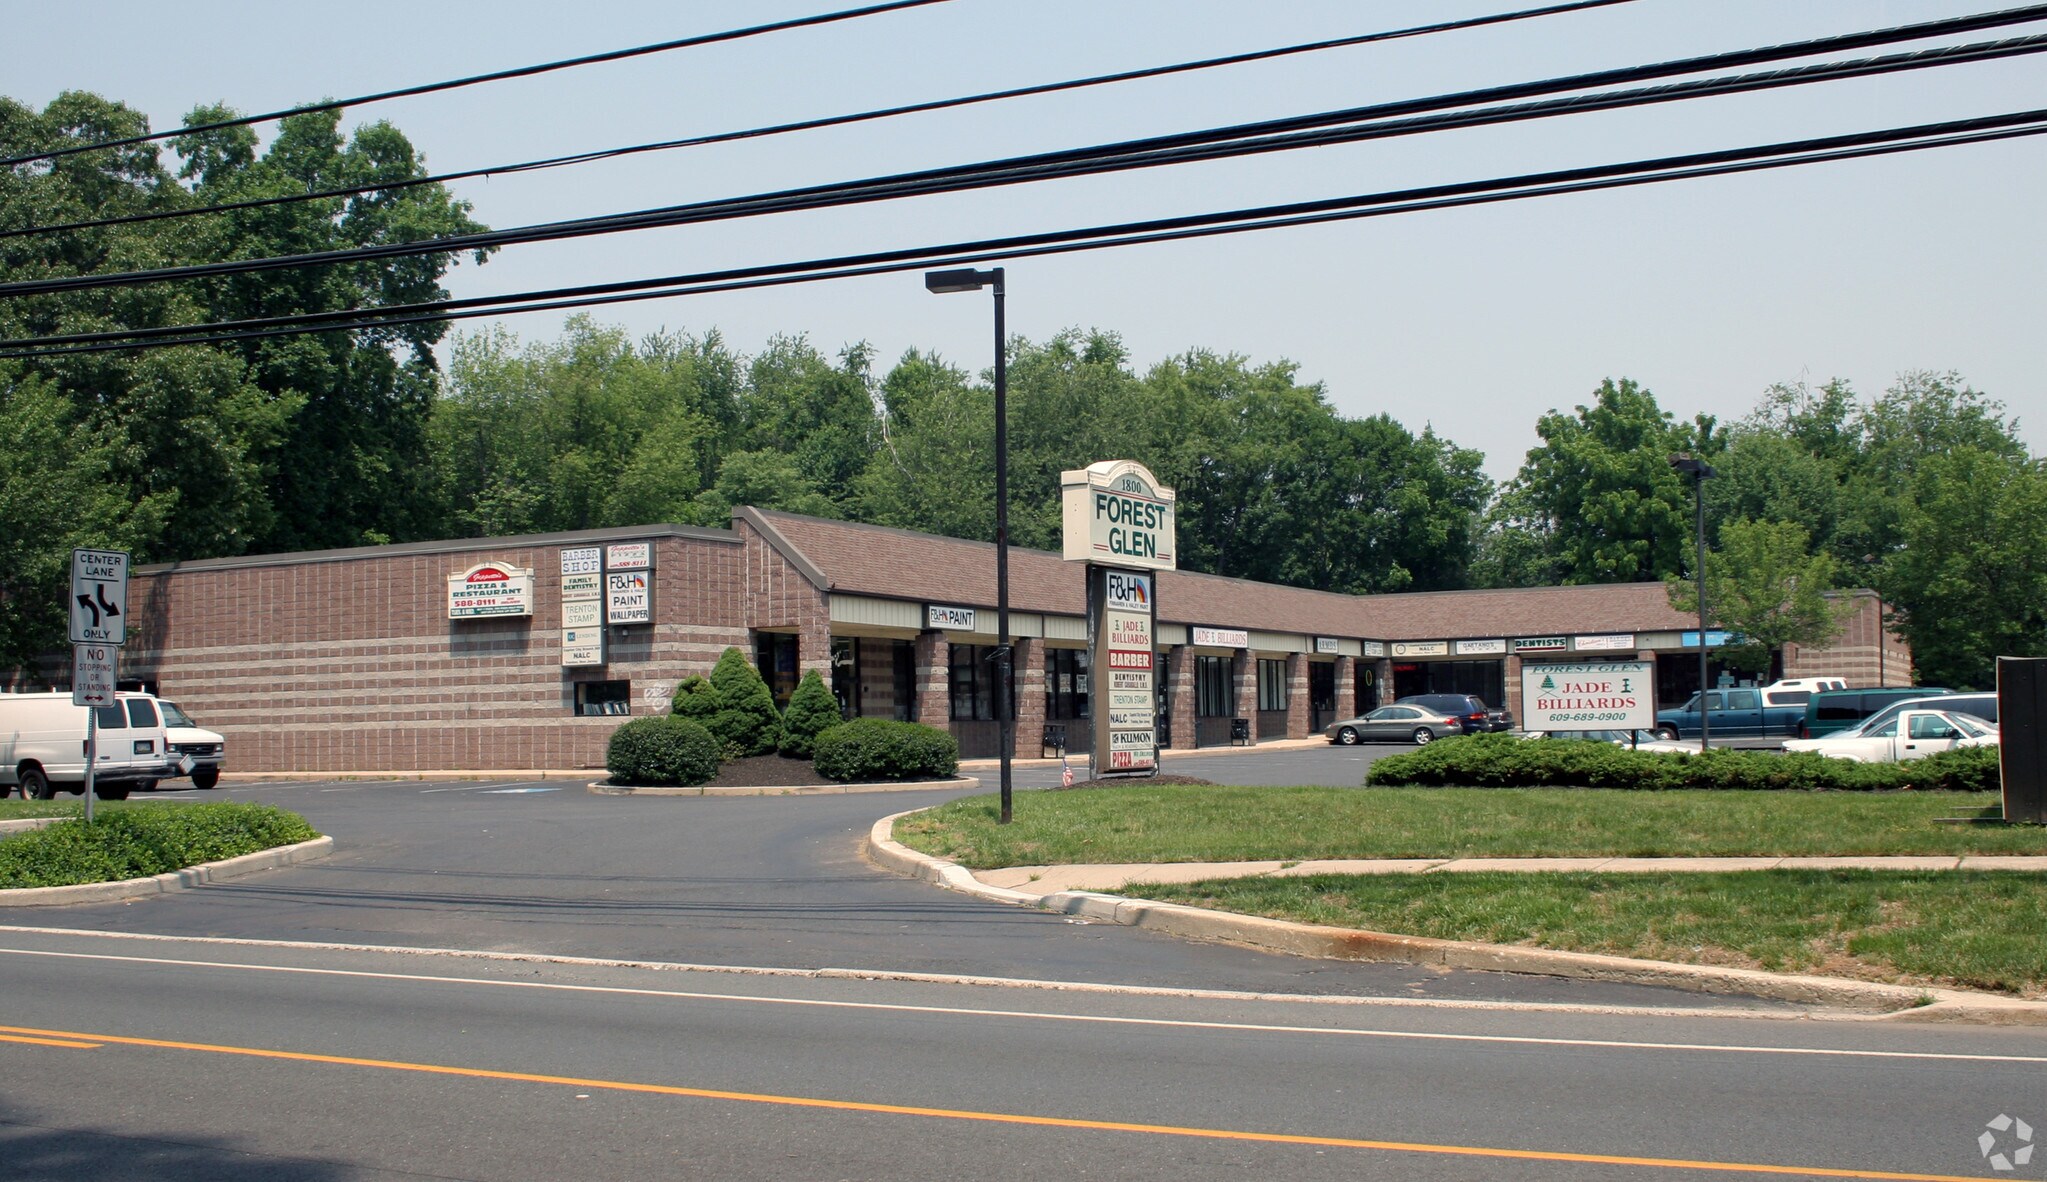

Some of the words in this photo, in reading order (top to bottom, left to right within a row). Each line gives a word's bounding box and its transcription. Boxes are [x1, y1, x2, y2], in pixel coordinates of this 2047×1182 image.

[1122, 479, 1141, 493] 1800
[1096, 494, 1166, 530] FOREST
[1109, 527, 1155, 558] GLEN
[80, 554, 121, 566] CENTER
[562, 550, 598, 561] BARBER
[85, 567, 115, 577] LANE
[563, 561, 599, 572] SHOP
[610, 575, 636, 589] F&H
[453, 588, 522, 597] RESTAURANT
[1109, 575, 1137, 602] F&H
[454, 599, 496, 607] 588-8111
[613, 595, 643, 607] PAINT
[565, 604, 598, 614] TRENTON
[568, 614, 595, 623] STAMP
[610, 610, 648, 620] WALLPAPER
[930, 608, 944, 620] F&H
[949, 610, 973, 625] PAINT
[1123, 620, 1139, 633] JADE
[83, 629, 111, 639] ONLY
[1112, 633, 1149, 645] BILLIARDS
[1195, 630, 1210, 643] JADE
[1217, 632, 1246, 645] BILLIARDS
[1515, 639, 1566, 647] DENTISTS
[87, 649, 104, 661] NO
[1110, 652, 1150, 667] BARBER
[79, 663, 112, 671] STOPPING
[1532, 665, 1593, 673] FOREST
[1598, 664, 1643, 673] GLEN
[90, 673, 100, 681] OR
[1115, 673, 1146, 681] DENTISTRY
[78, 684, 111, 692] STANDING
[1562, 682, 1613, 694] JADE
[1114, 695, 1133, 704] TRENTON
[1134, 695, 1148, 704] STAMP
[1537, 697, 1636, 710] BILLIARDS
[1110, 713, 1128, 723] NALC
[1549, 712, 1626, 722] 609-689-0900
[1120, 733, 1151, 743] KUMON
[1112, 752, 1132, 767] PIZZA
